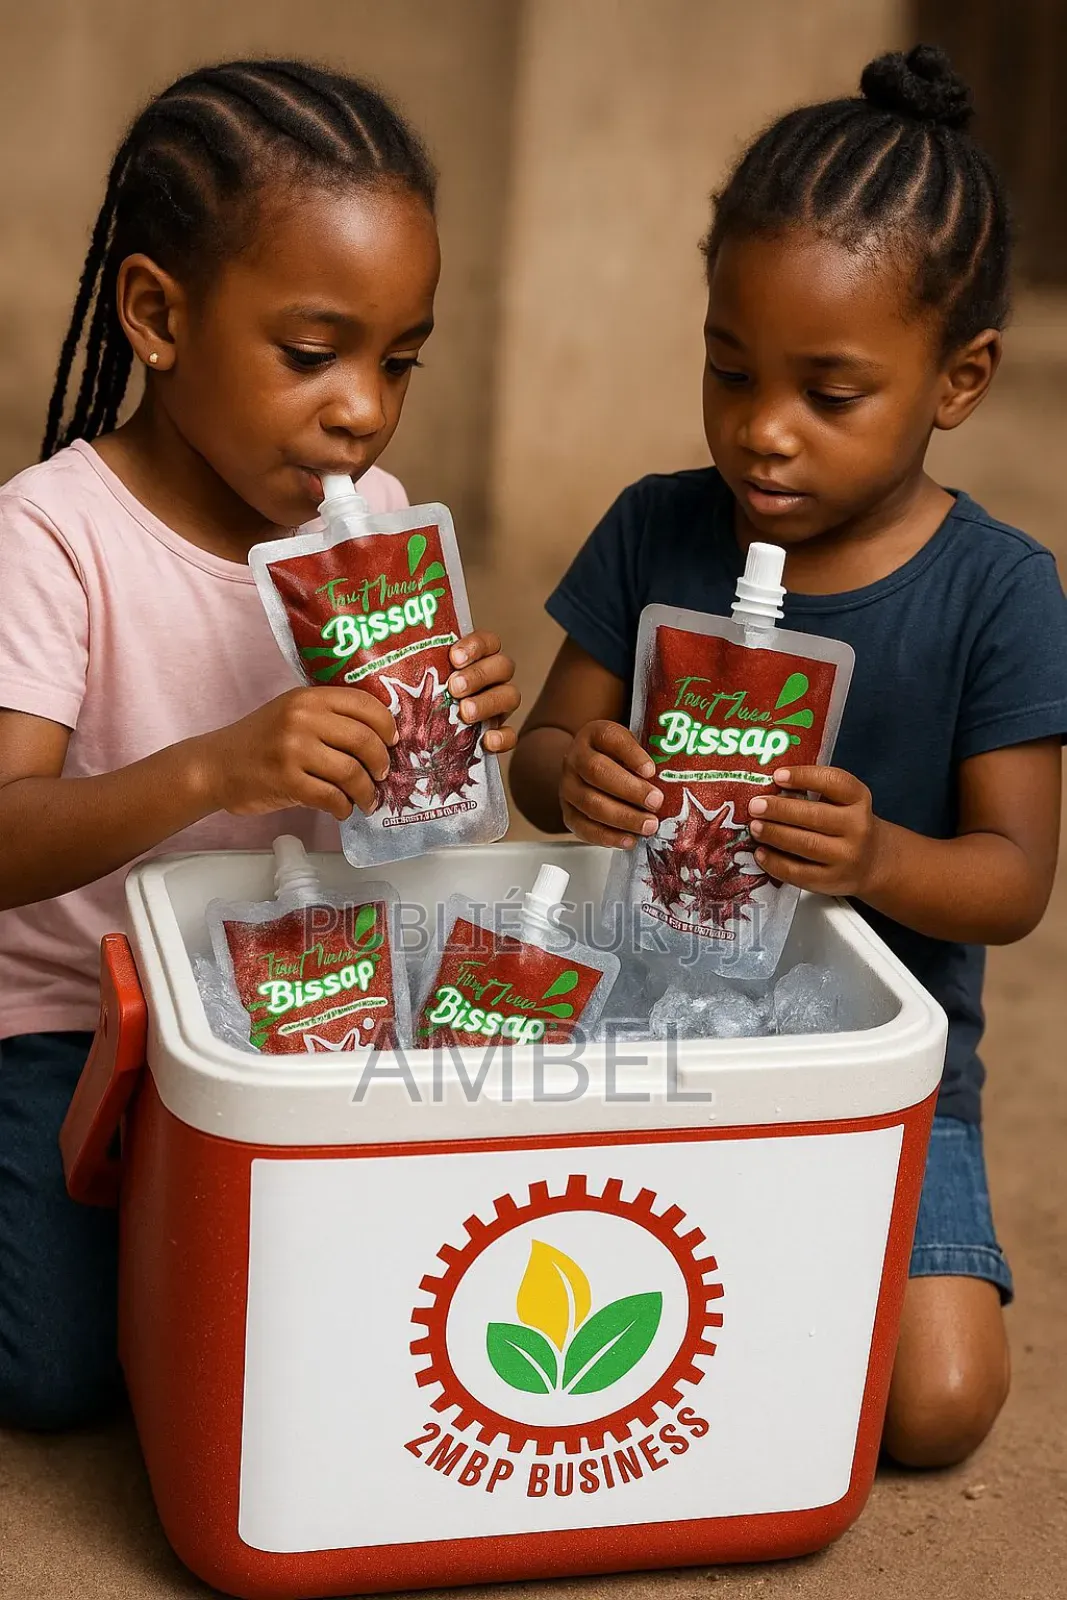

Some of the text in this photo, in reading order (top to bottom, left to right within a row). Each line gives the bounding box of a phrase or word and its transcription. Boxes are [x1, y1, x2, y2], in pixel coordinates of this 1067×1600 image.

[322, 592, 438, 656] Bissap
[659, 711, 790, 765] Bissap
[258, 960, 375, 1013] Bissap
[430, 986, 545, 1044] Bissap
[404, 1406, 710, 1497] 2MBP BUSINESS
